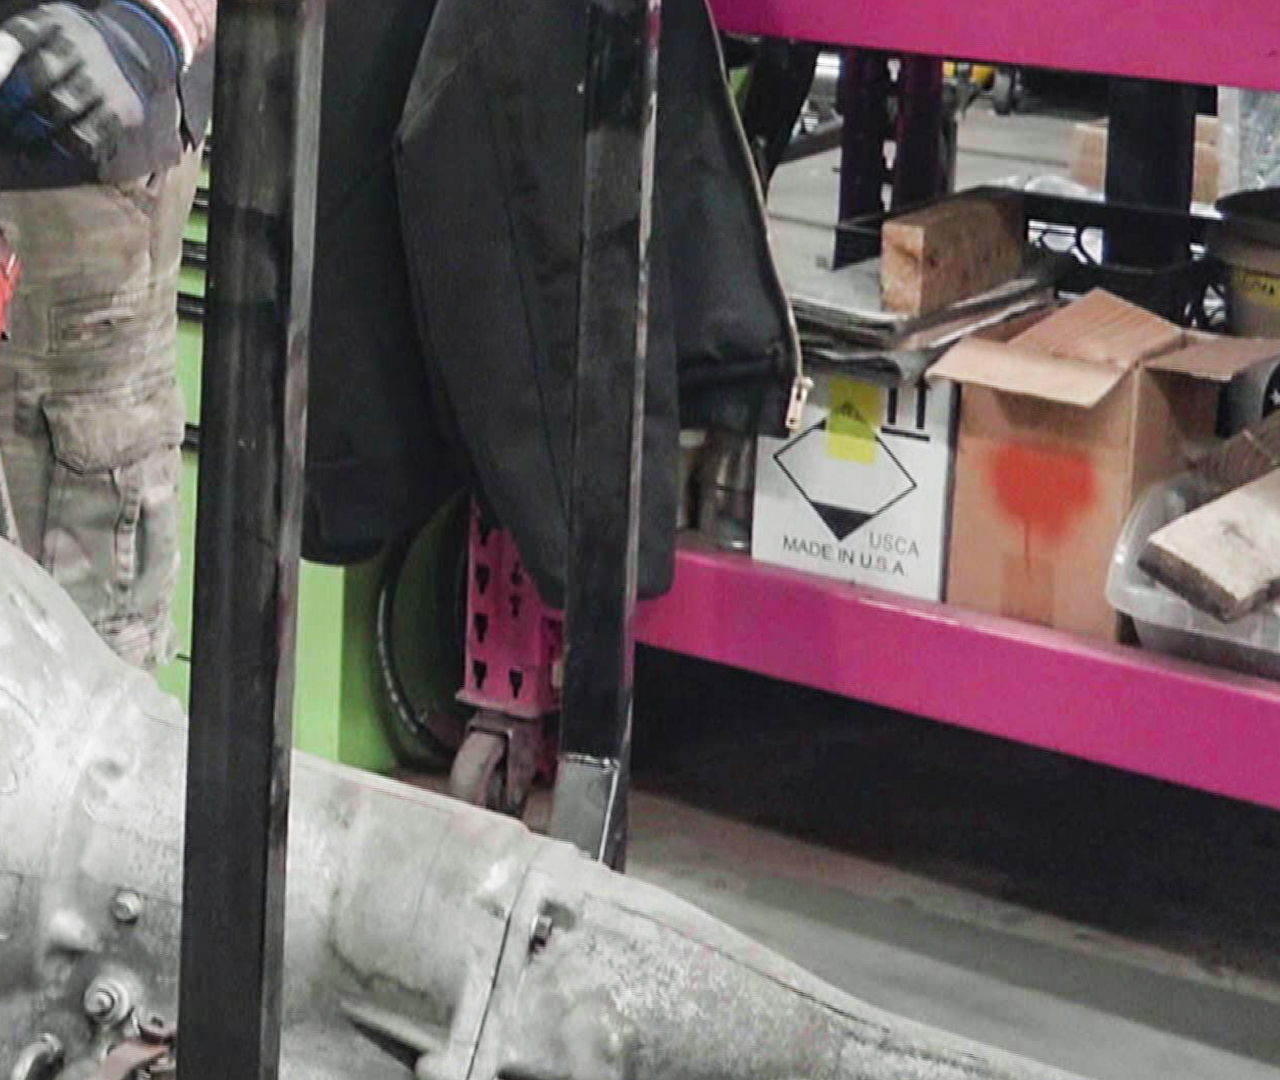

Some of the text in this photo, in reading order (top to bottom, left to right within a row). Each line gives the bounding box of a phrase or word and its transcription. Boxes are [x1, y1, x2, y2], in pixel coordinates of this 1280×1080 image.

[783, 535, 832, 561] MADE
[837, 547, 855, 565] IN
[869, 531, 920, 559] USCA
